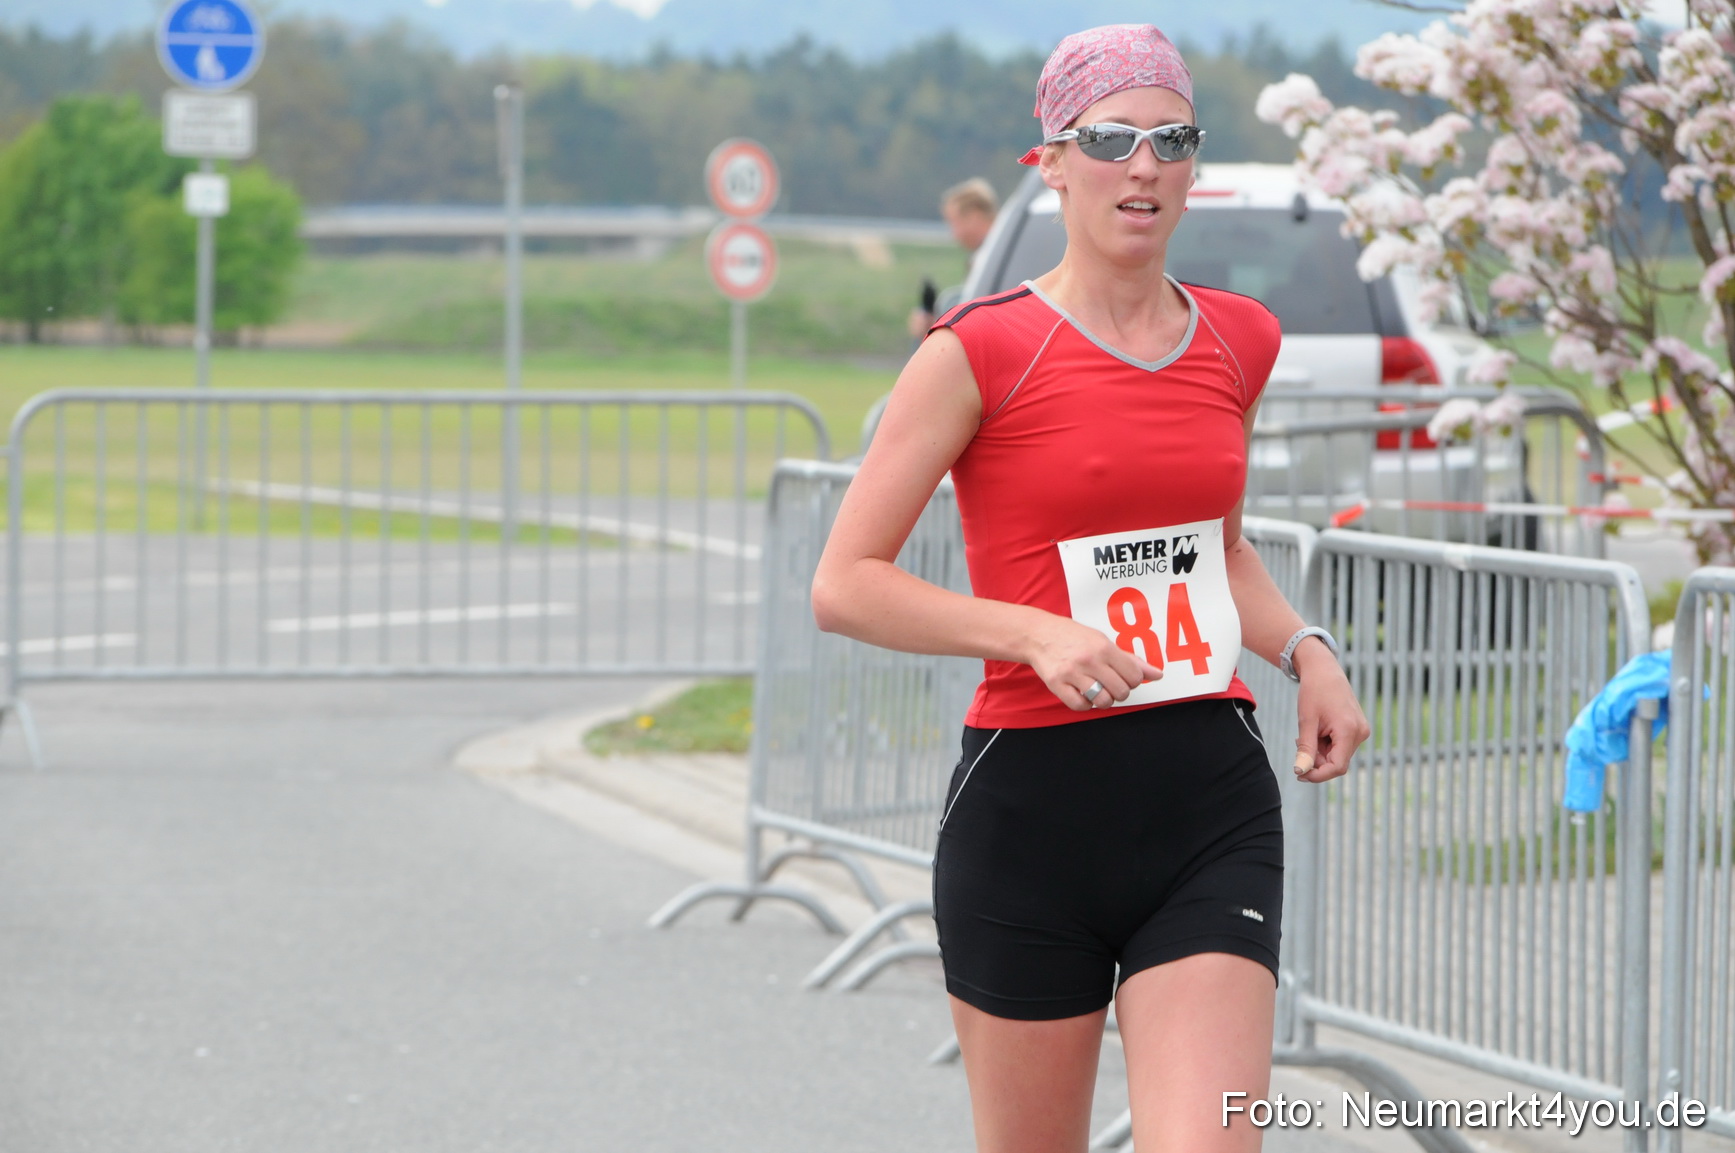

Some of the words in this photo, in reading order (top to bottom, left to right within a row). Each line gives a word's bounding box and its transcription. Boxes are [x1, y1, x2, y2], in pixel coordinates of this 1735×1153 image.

[1093, 539, 1167, 566] MEYER
[1096, 560, 1168, 580] WERBUNG
[1106, 582, 1212, 684] 84
